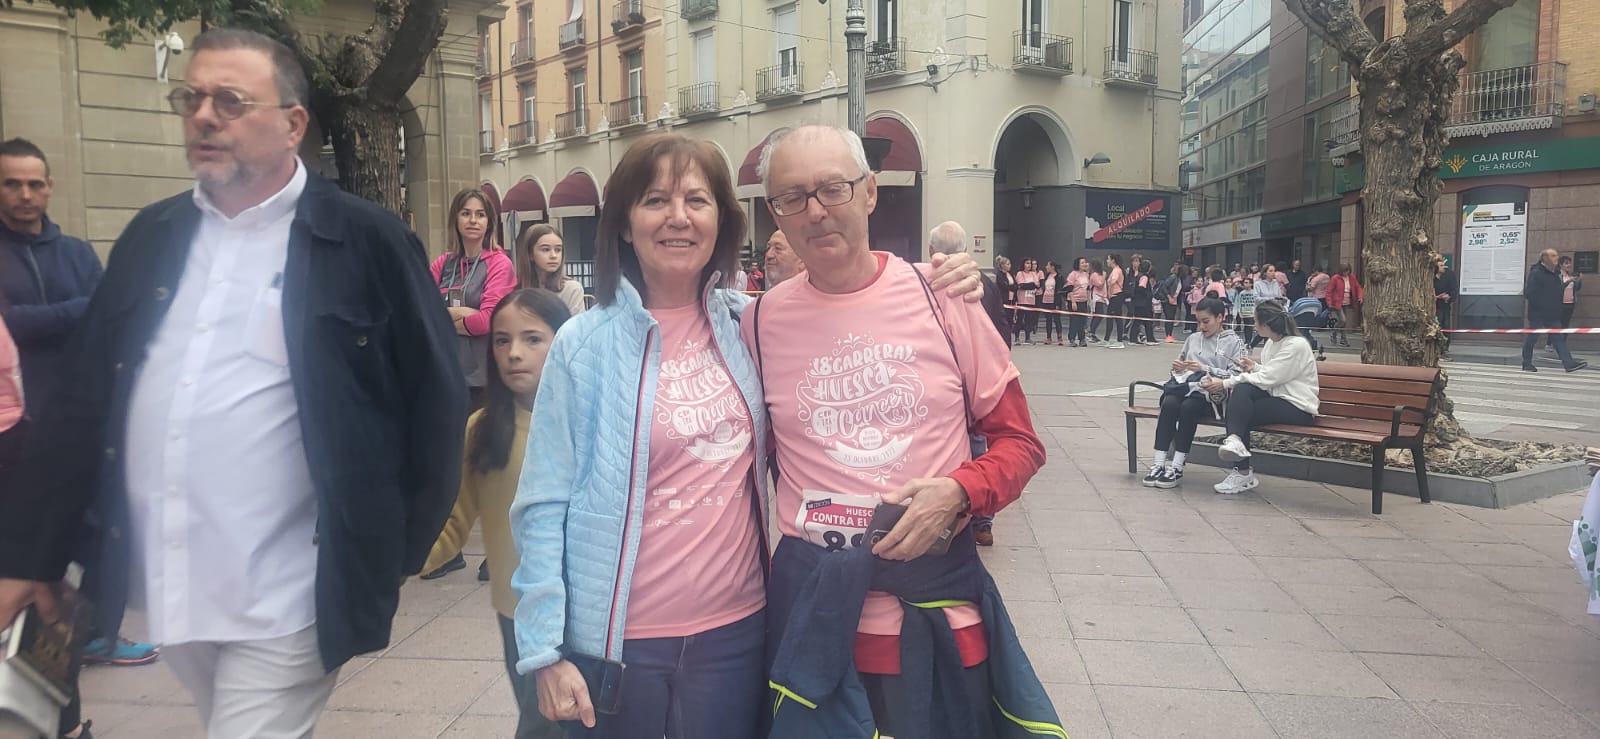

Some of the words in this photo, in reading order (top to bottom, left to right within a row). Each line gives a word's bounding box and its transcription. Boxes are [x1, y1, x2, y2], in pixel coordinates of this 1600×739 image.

[1472, 153, 1499, 163] CAJA
[1502, 149, 1540, 161] RURAL
[1107, 203, 1125, 212] Local
[1108, 206, 1151, 234] ALQUILADO
[811, 361, 890, 401] HUESCA
[812, 511, 854, 527] CONTRA
[857, 518, 869, 527] EL
[846, 507, 873, 517] HUESC
